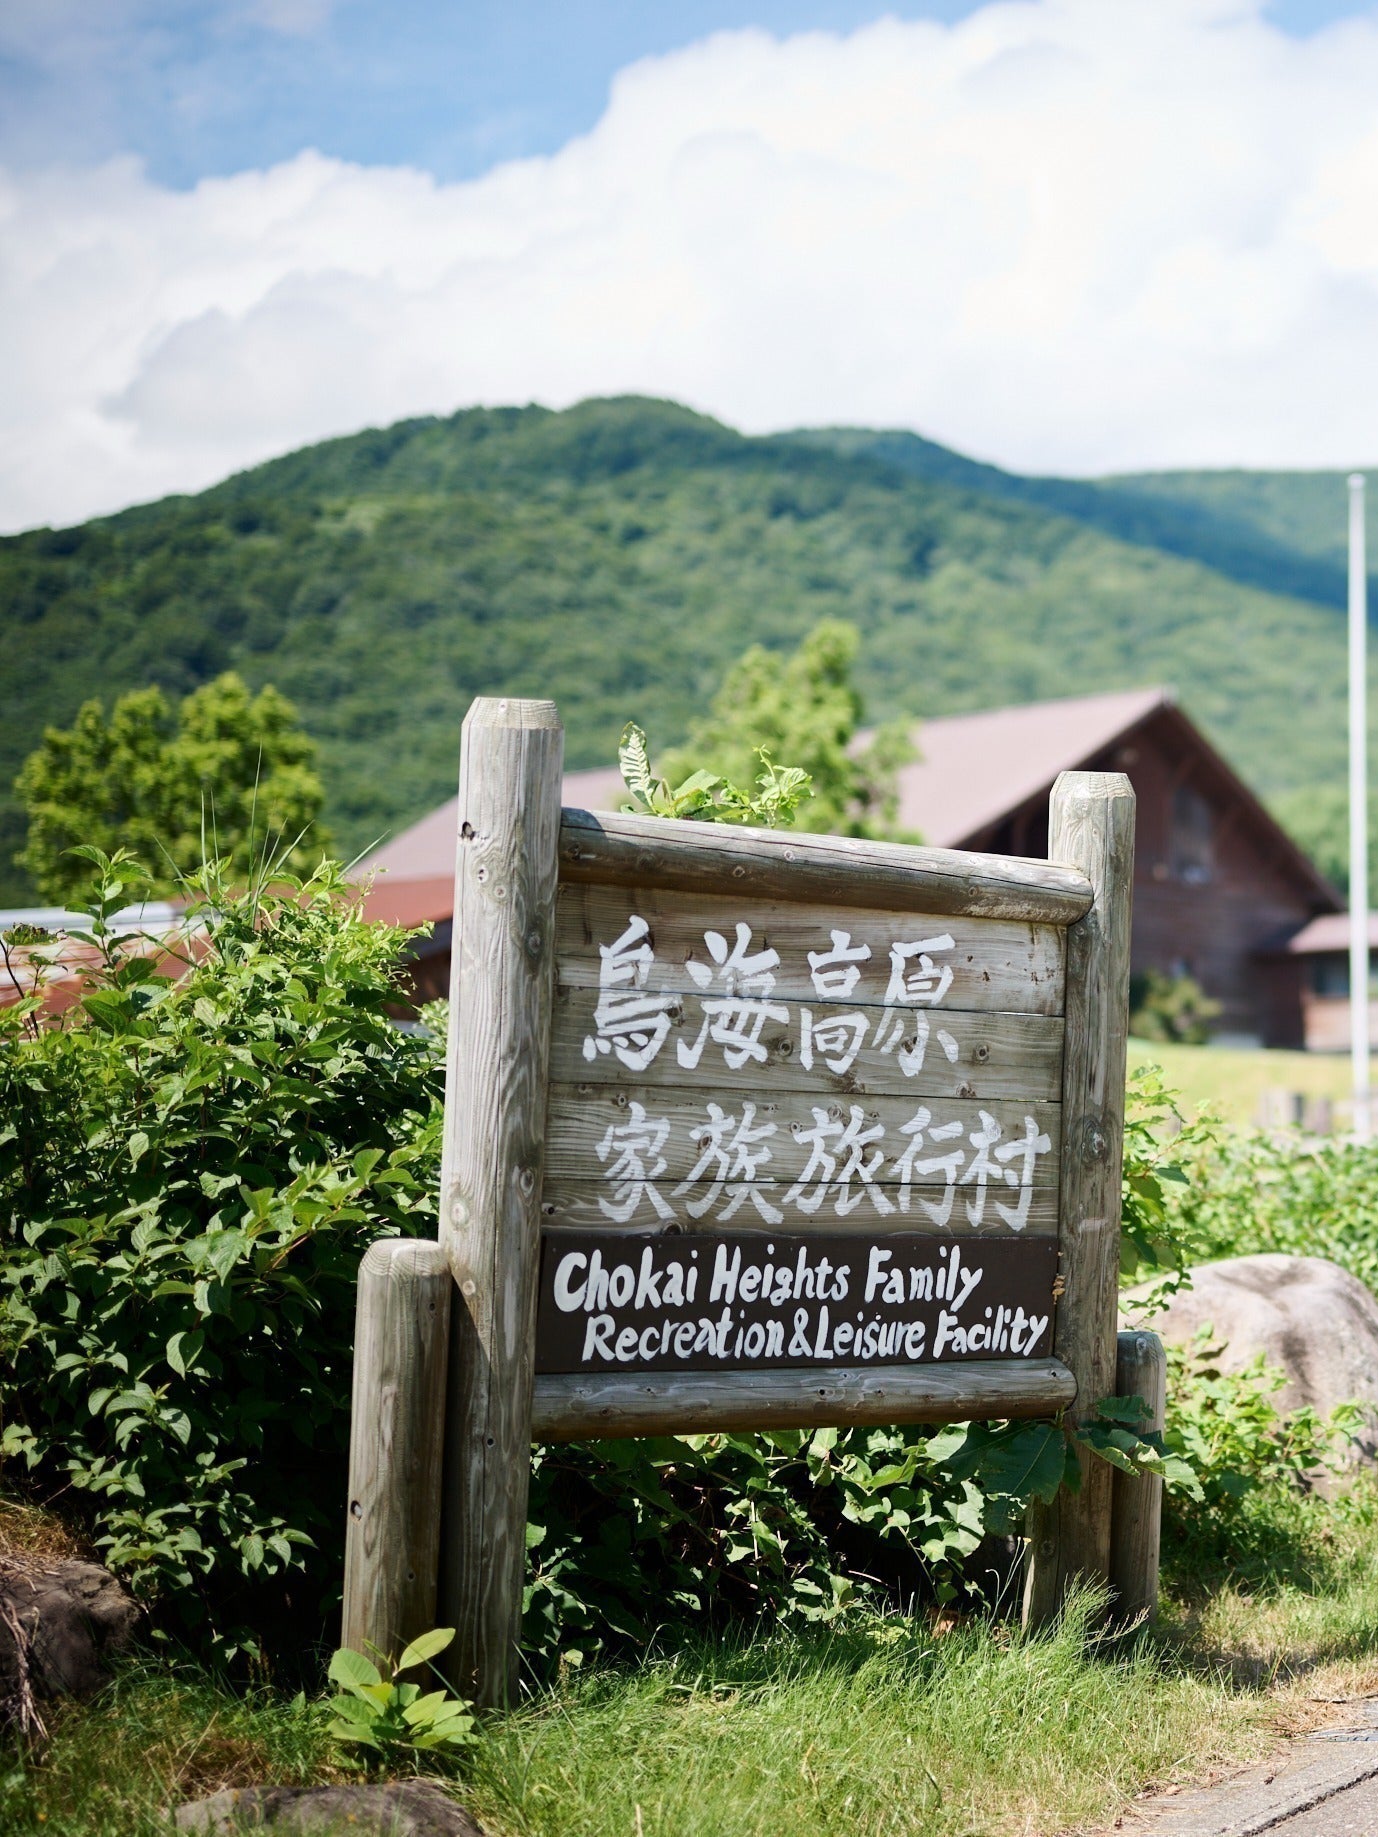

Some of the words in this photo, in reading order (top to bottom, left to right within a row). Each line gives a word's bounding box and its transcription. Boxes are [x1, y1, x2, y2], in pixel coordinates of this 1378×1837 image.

[583, 915, 958, 1076] 鳥海高原
[597, 1102, 1052, 1231] 家族旅行村
[554, 1246, 697, 1312] Chokai
[709, 1244, 849, 1304] Heights
[865, 1246, 983, 1312] Family
[932, 1305, 1049, 1359] Facility
